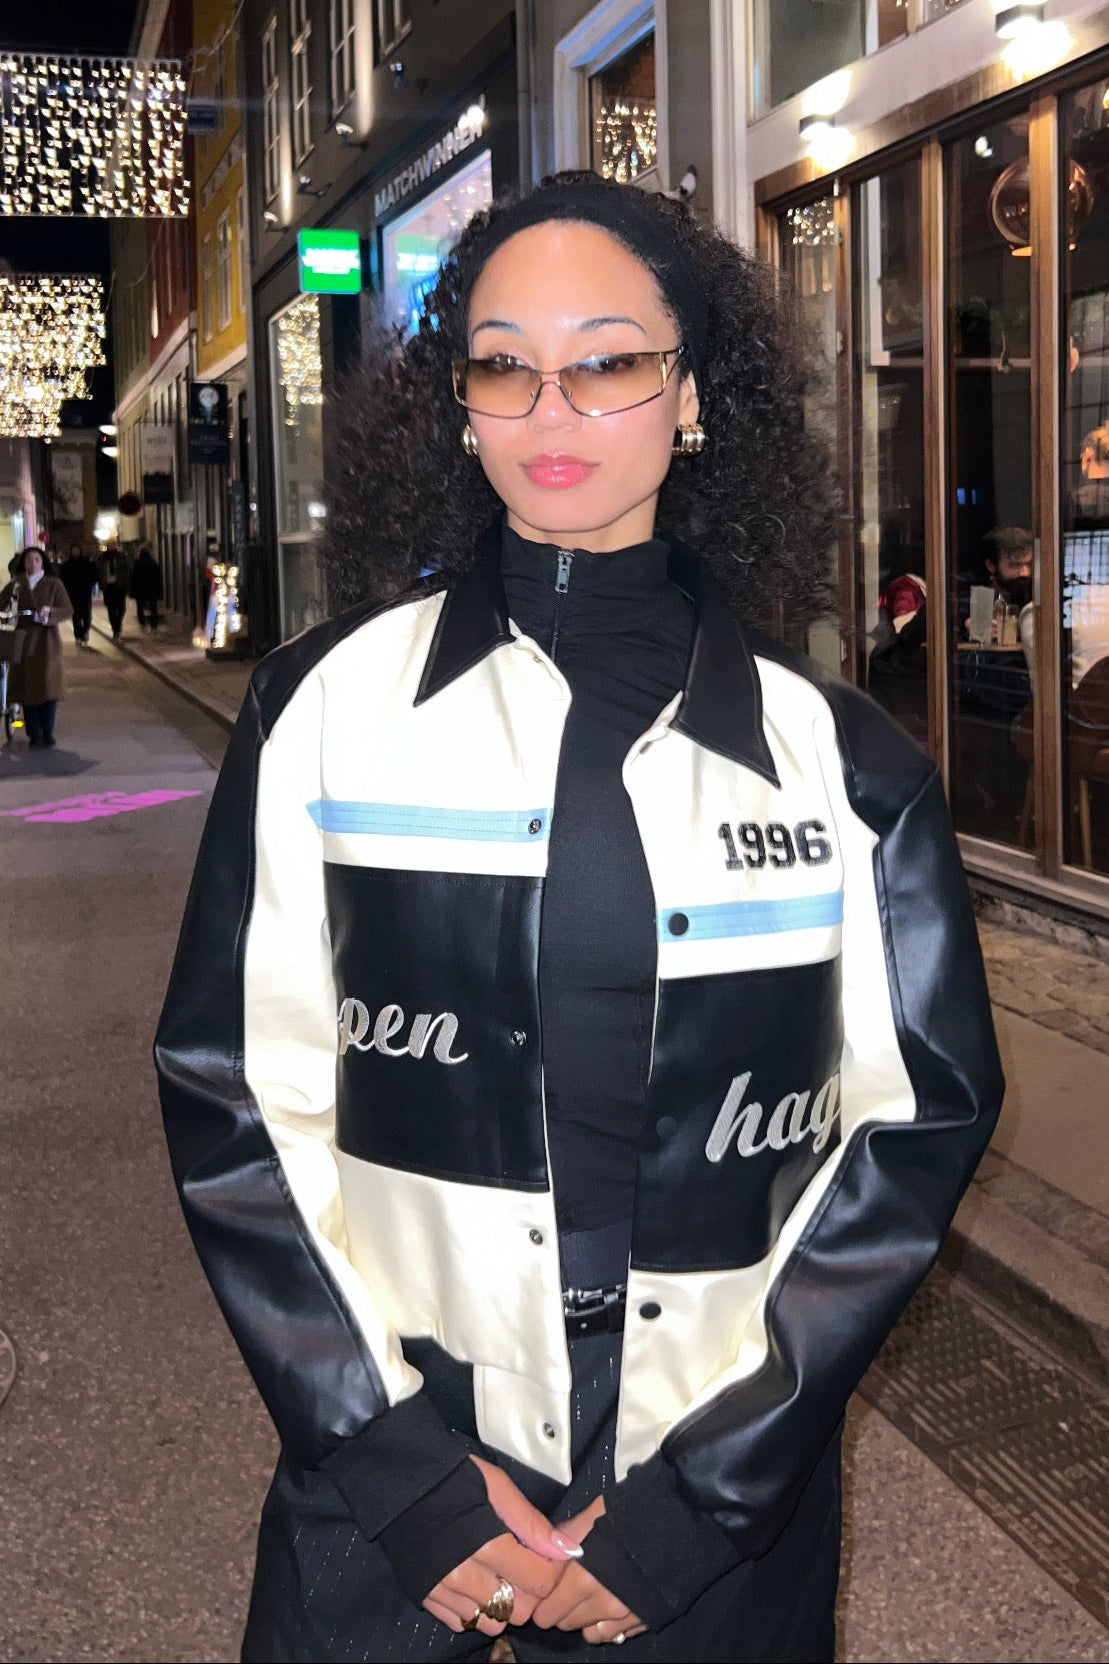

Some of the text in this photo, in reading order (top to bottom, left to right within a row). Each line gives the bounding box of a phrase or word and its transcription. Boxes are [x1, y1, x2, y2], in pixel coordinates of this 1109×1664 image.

[717, 818, 833, 871] 1996
[337, 997, 469, 1064] pen
[705, 1071, 841, 1163] hag
